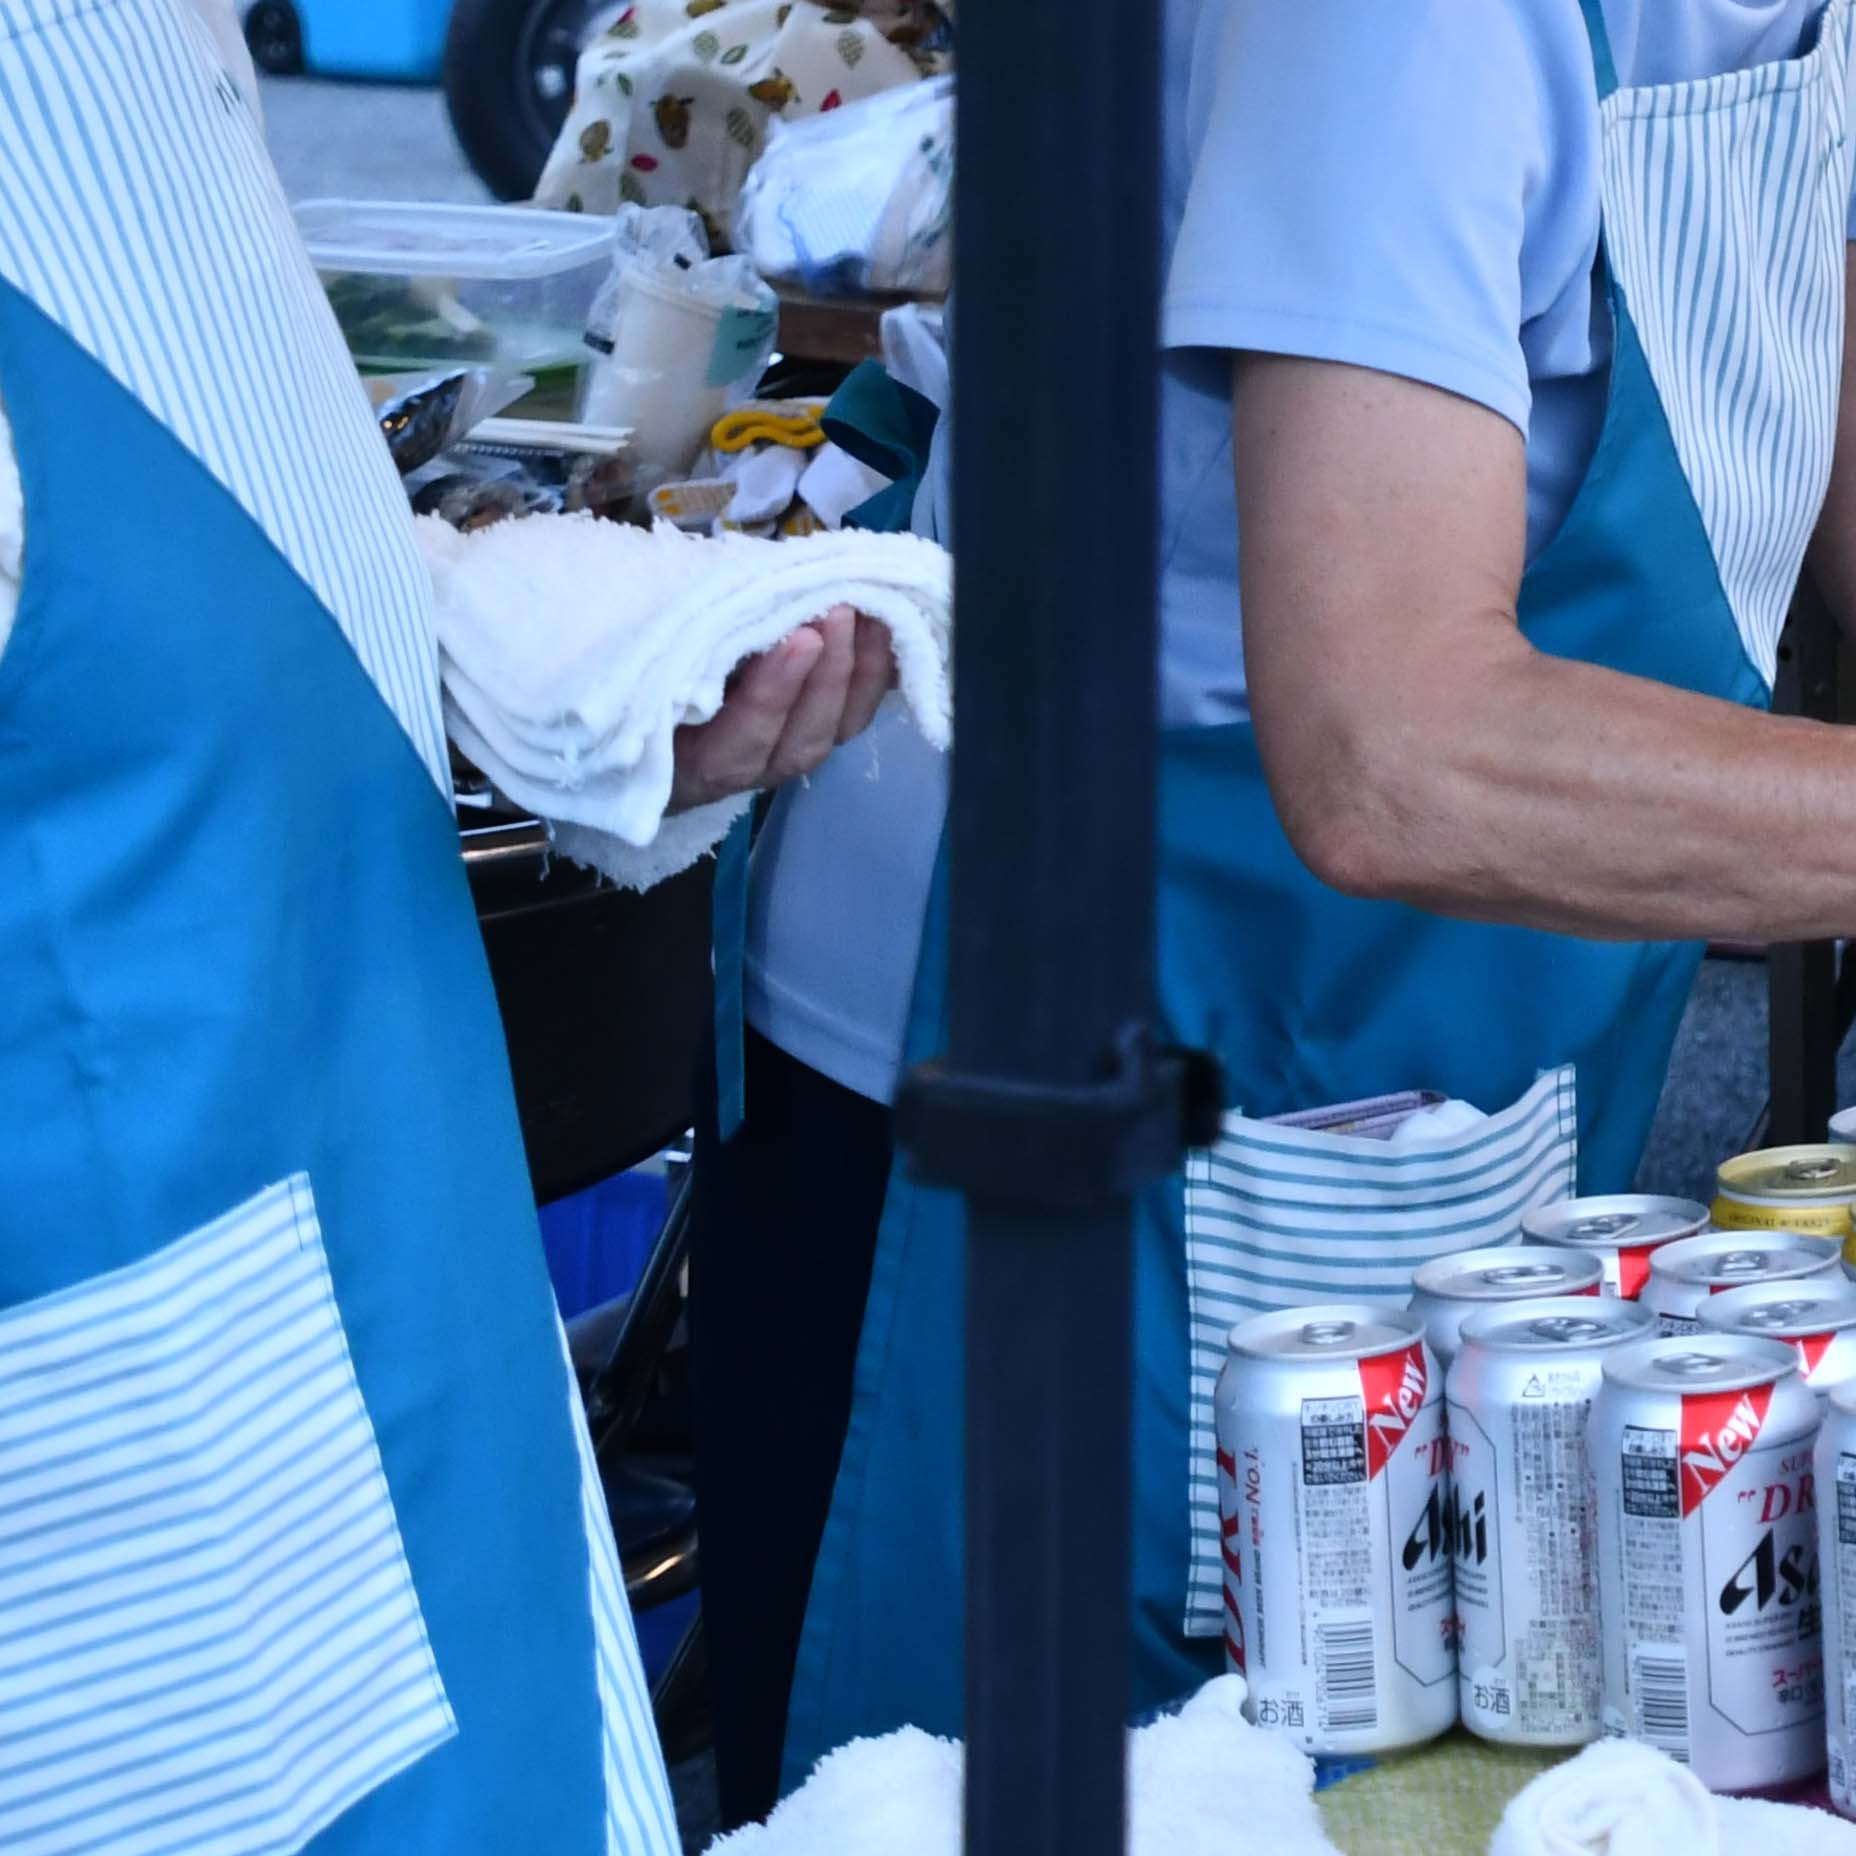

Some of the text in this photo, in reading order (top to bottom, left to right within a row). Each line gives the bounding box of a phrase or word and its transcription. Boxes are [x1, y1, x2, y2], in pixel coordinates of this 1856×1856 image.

[1369, 1353, 1427, 1456] New
[1682, 1393, 1761, 1493] New
[1259, 1698, 1305, 1728] お酒
[1473, 1683, 1511, 1715] お酒
